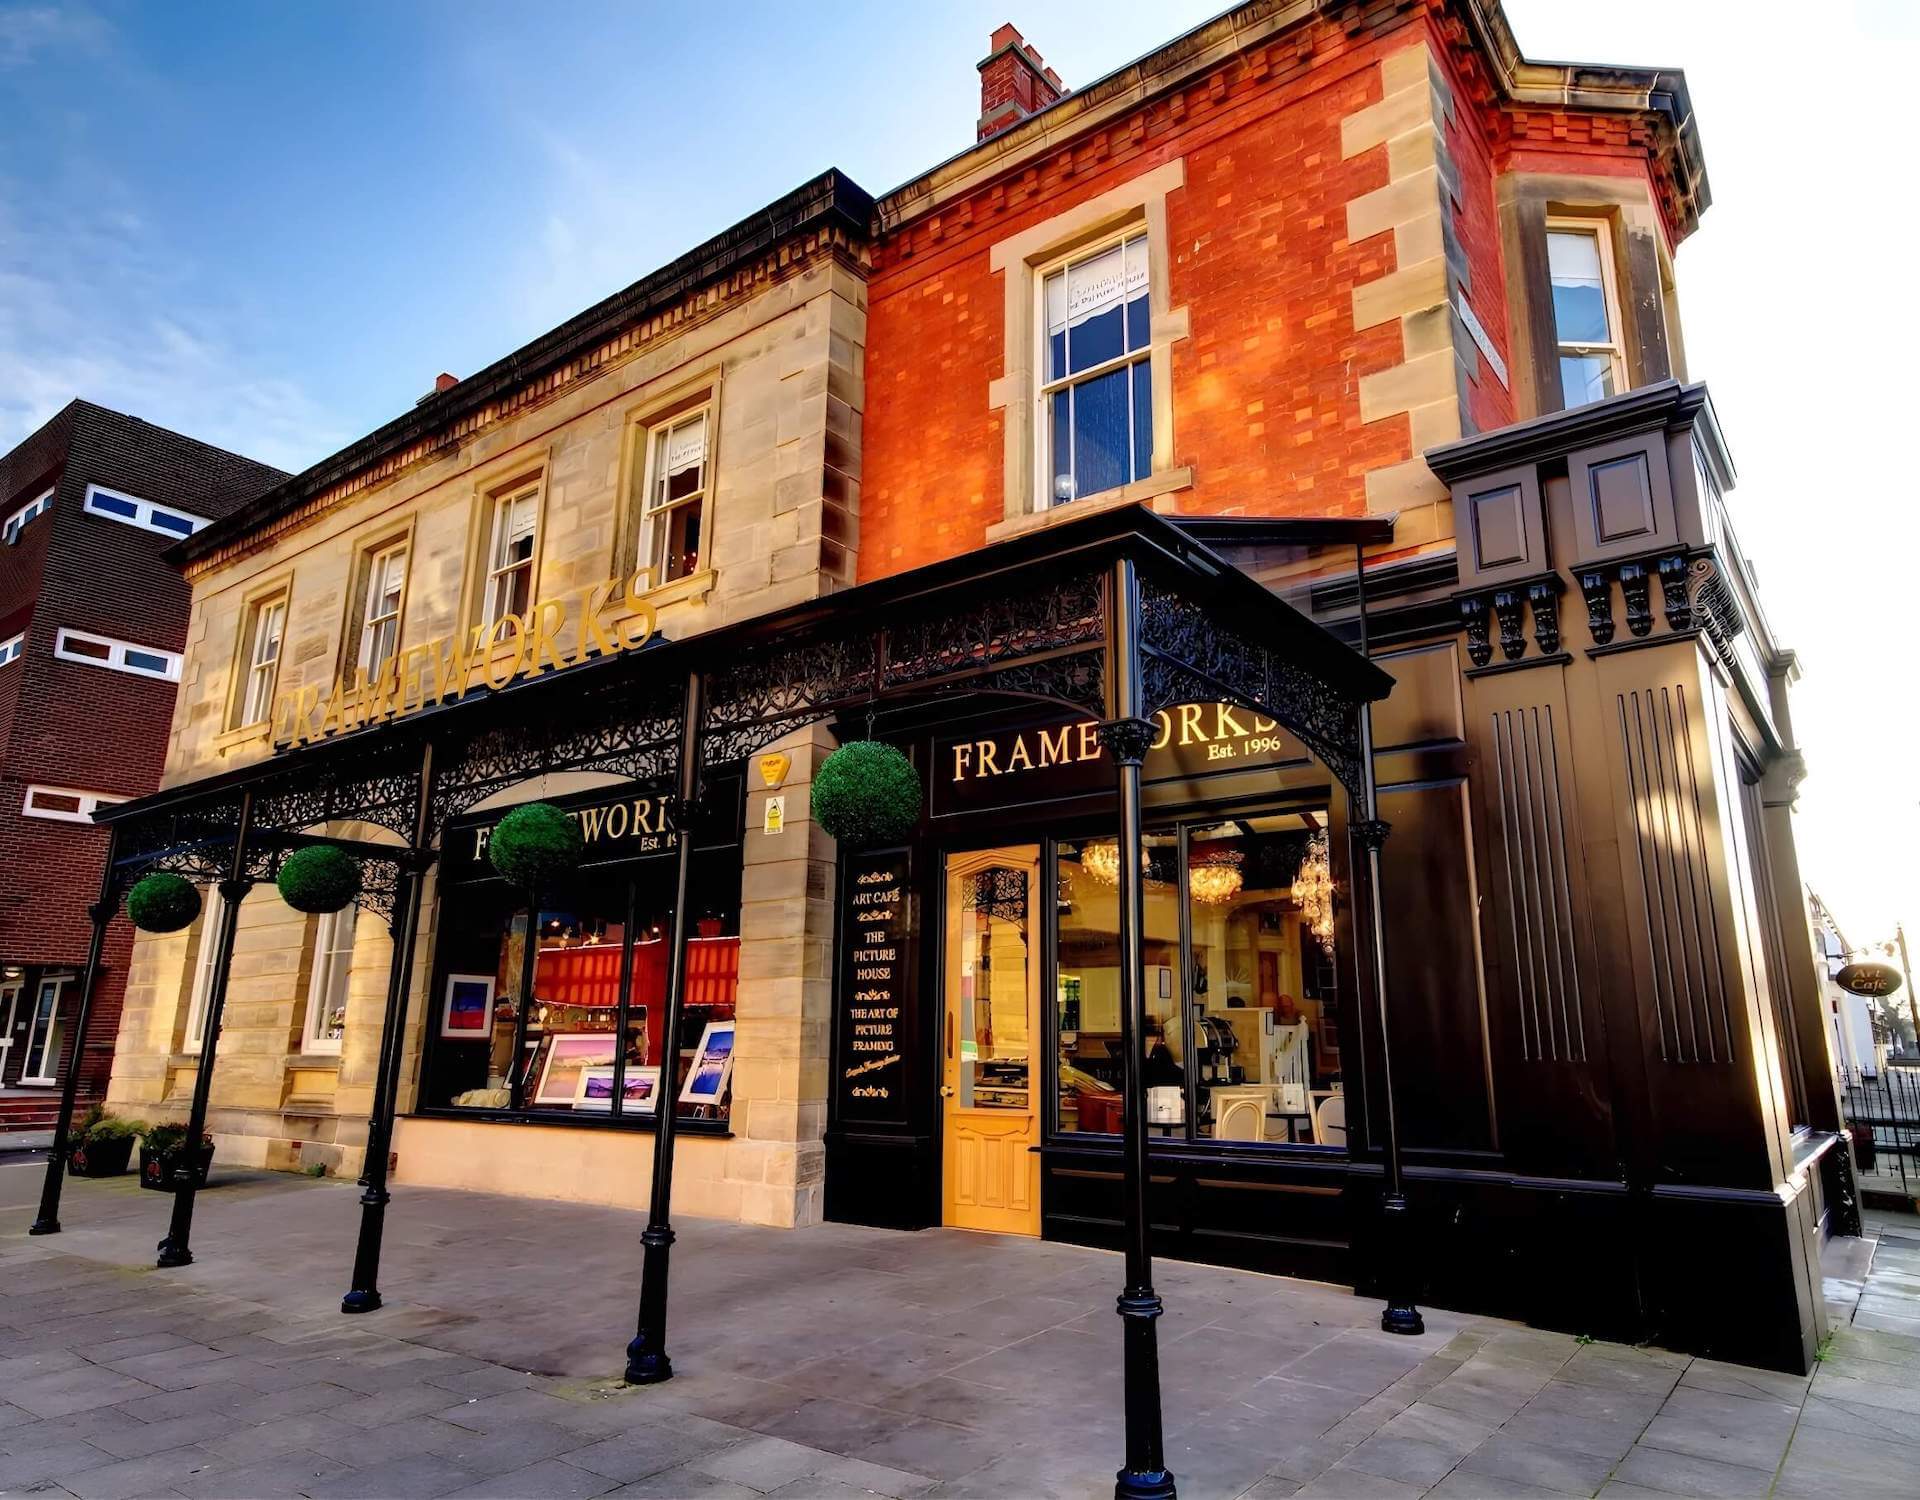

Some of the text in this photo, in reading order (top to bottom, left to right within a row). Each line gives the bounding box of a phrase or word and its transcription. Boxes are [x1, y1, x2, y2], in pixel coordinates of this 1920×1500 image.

[270, 566, 661, 752] FRAMEWORKS
[952, 701, 1277, 782] FRAMEORK
[1207, 735, 1281, 761] Est. 1996
[640, 836, 661, 852] Est.
[852, 892, 872, 905] ART
[863, 930, 886, 944] THE
[853, 948, 896, 962] PICTURE
[857, 967, 891, 980] HOUSE
[850, 1007, 899, 1019] THE ART OF
[855, 1023, 893, 1036] PICTURE
